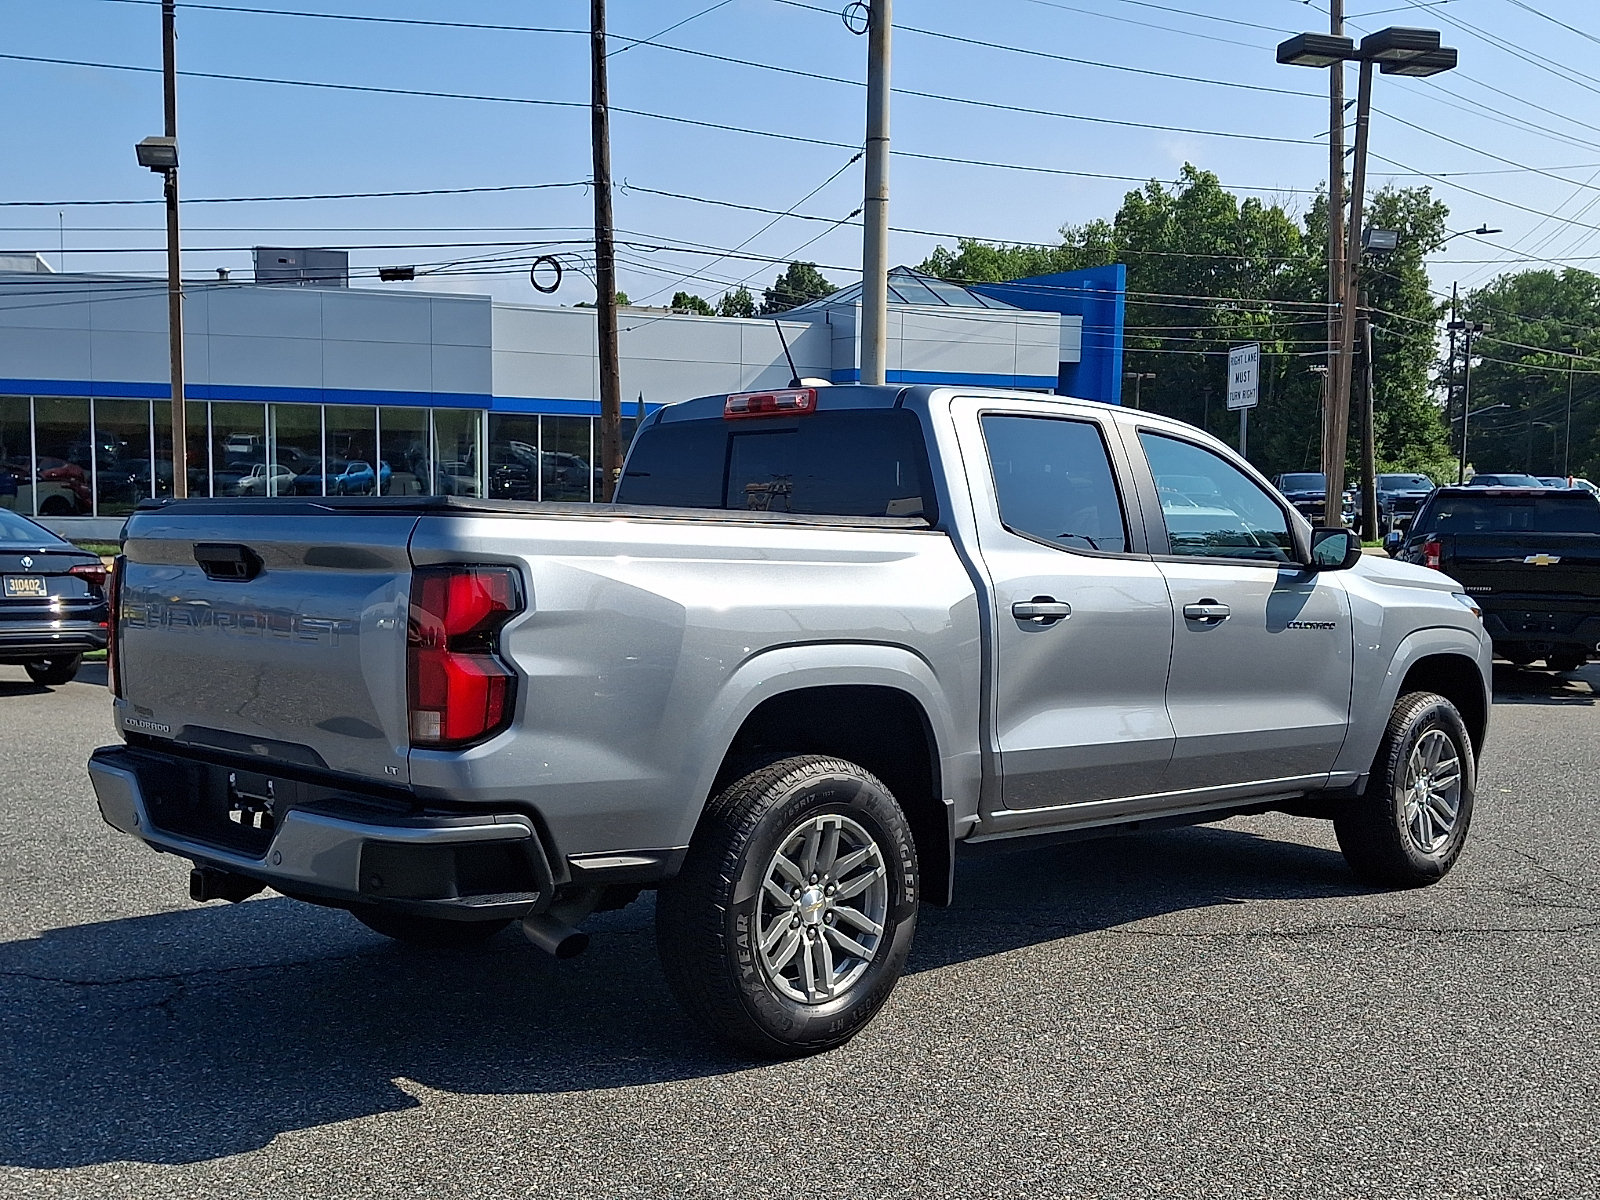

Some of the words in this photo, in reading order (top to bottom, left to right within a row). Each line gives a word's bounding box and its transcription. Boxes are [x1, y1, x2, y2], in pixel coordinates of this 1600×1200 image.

[1230, 354, 1244, 366] RIGHT
[1244, 351, 1257, 364] LANE
[1235, 370, 1251, 384] MUST
[1230, 390, 1241, 402] TURN
[1242, 388, 1256, 400] RIGHT
[9, 578, 41, 591] 310402
[125, 602, 352, 648] CHEVROLET
[125, 717, 170, 733] COLORADO
[384, 765, 399, 776] LT
